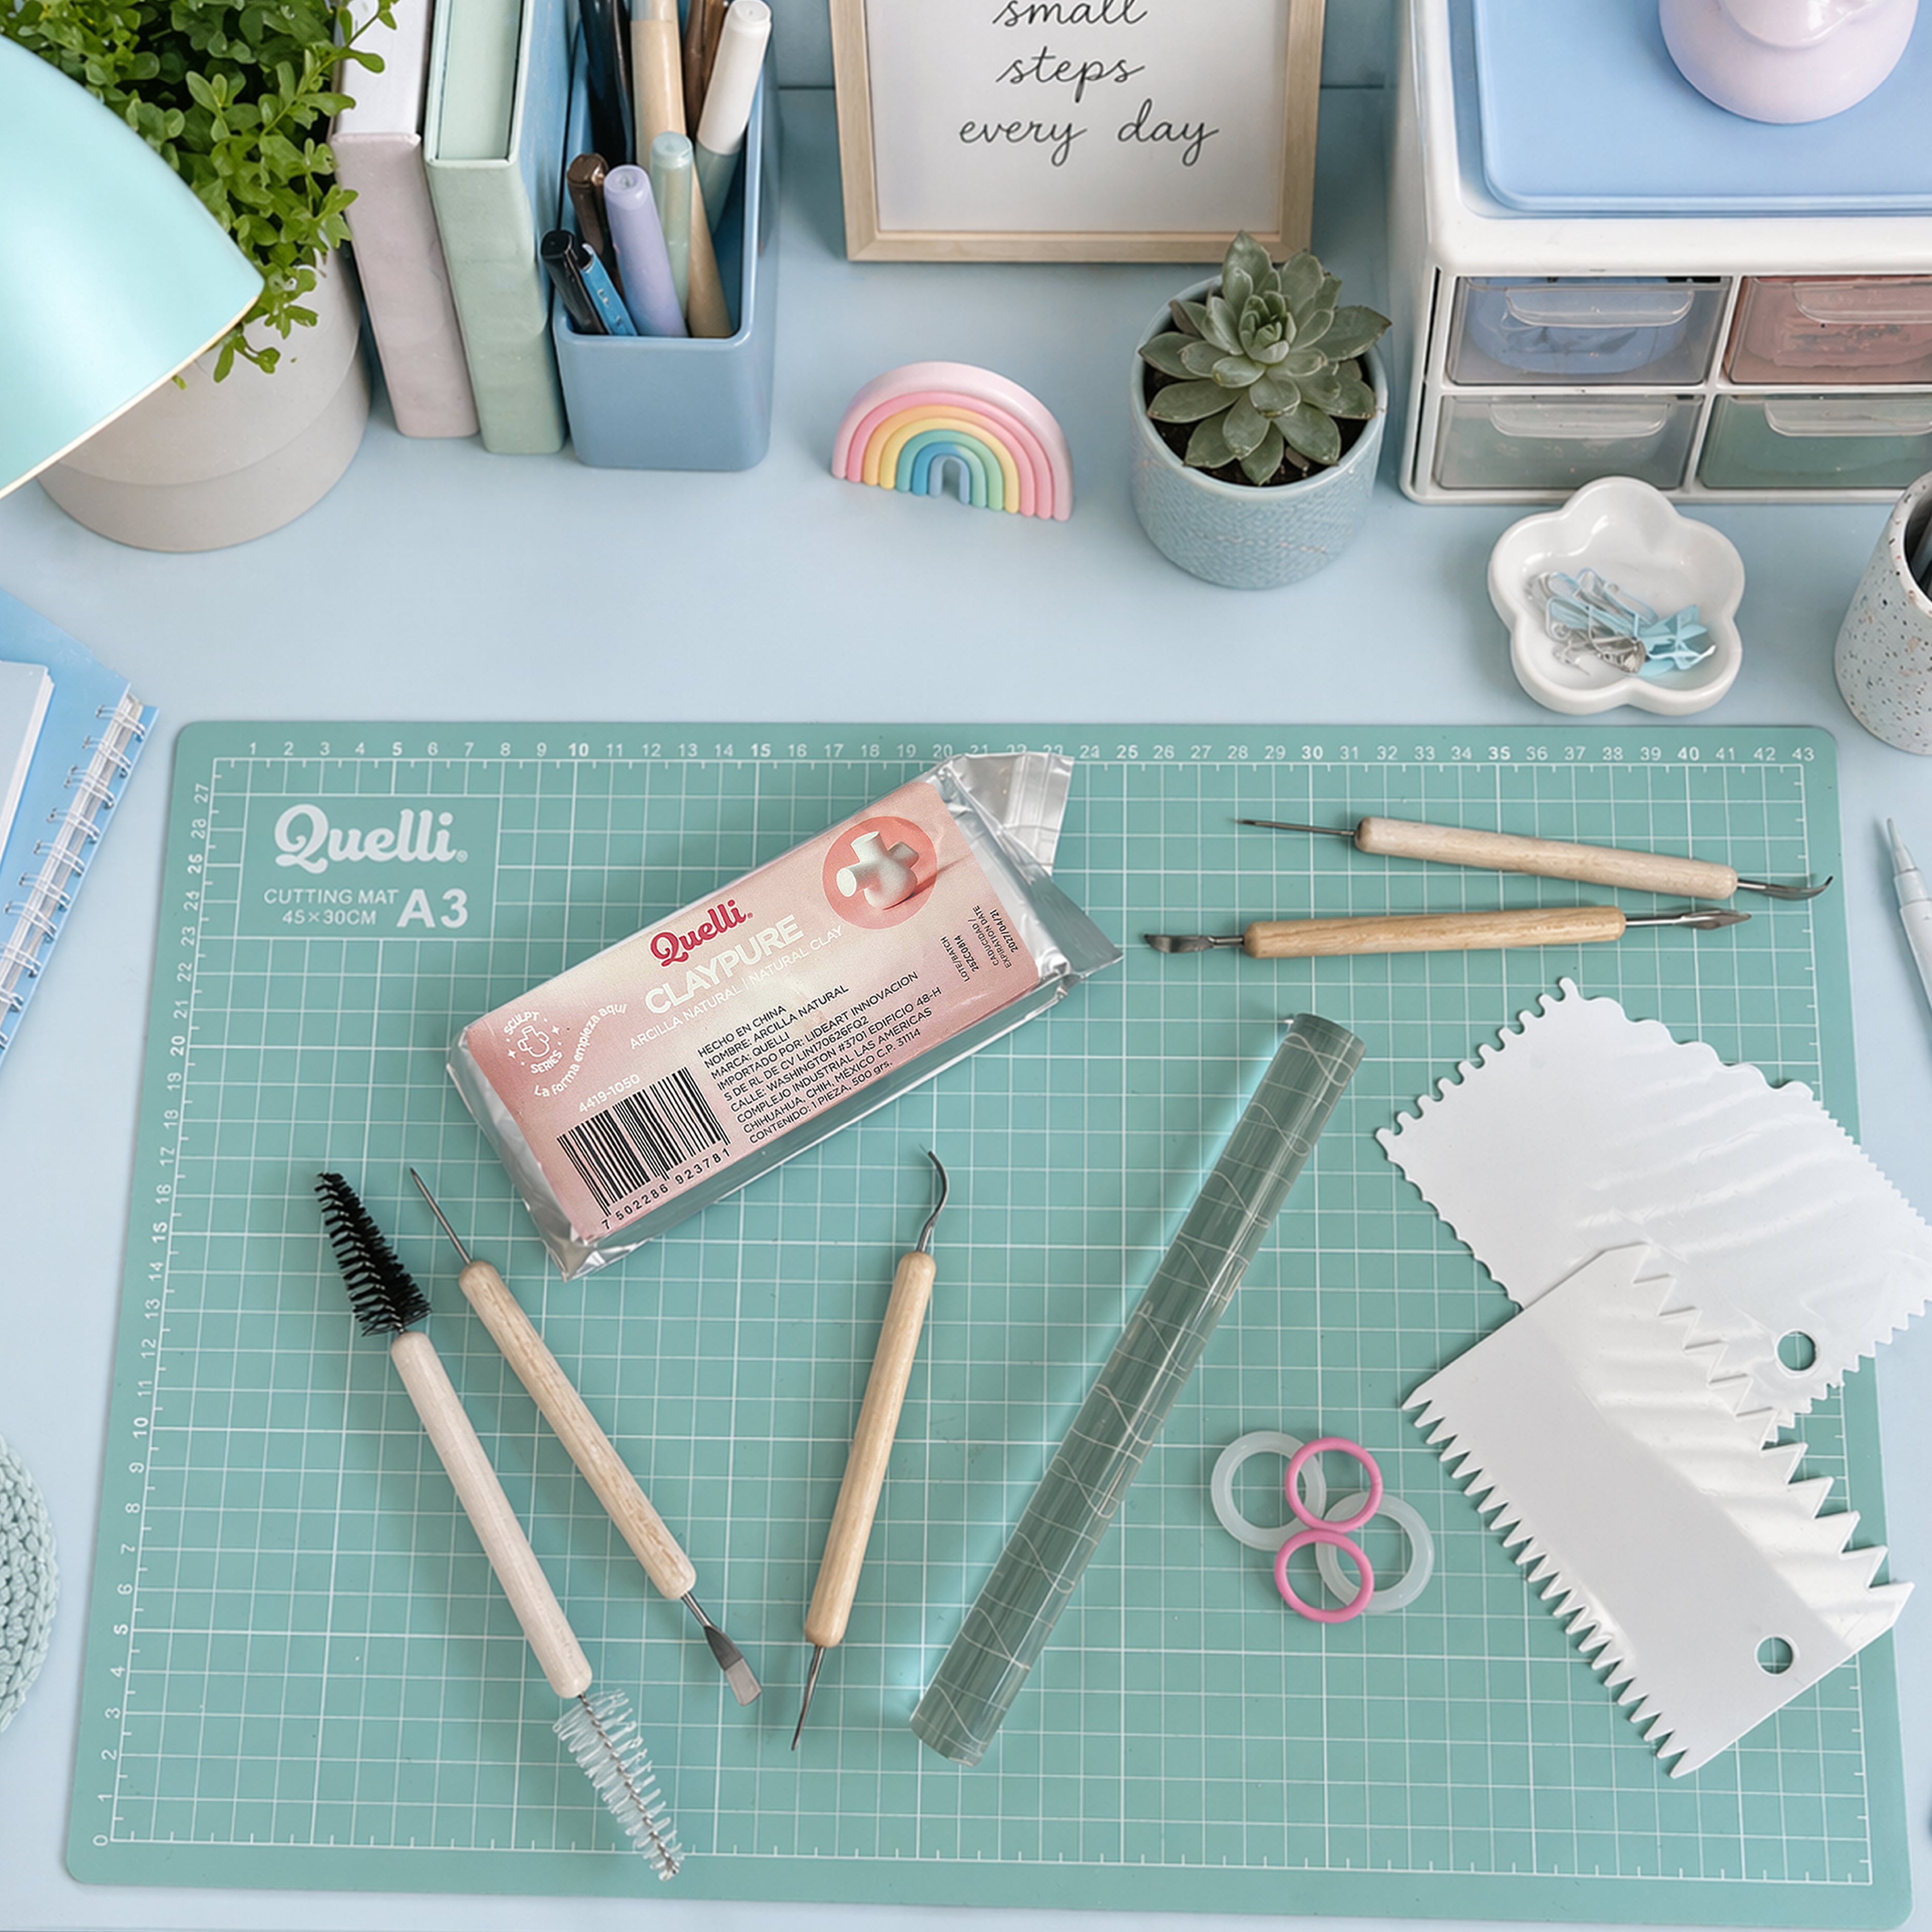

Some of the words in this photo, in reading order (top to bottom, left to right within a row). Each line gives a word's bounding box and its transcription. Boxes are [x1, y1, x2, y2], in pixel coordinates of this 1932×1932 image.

[992, 0, 1148, 27] small
[996, 46, 1146, 103] steps
[959, 118, 1088, 167] every
[1117, 98, 1220, 167] day
[250, 742, 256, 755] 1
[284, 742, 293, 756] 2
[320, 742, 330, 756] 3
[355, 742, 364, 756] 4
[392, 742, 402, 756] 5
[428, 742, 438, 756] 6
[465, 743, 474, 756] 7
[500, 743, 510, 756] 8
[537, 743, 546, 757] 9
[569, 743, 589, 757] 10
[607, 743, 622, 757] 11
[642, 743, 661, 757] 12
[679, 743, 697, 757] 13
[715, 743, 733, 757] 14
[751, 744, 770, 757] 15
[789, 744, 807, 757] 16
[825, 744, 843, 758] 17
[862, 744, 879, 758] 18
[898, 744, 915, 758] 19
[933, 744, 952, 758] 20
[1154, 745, 1174, 759] 26
[1191, 745, 1212, 759] 27
[1228, 745, 1248, 759] 28
[1265, 745, 1285, 759] 29
[1302, 746, 1323, 759] 30
[1340, 746, 1357, 760] 31
[1378, 746, 1397, 760] 32
[1415, 746, 1435, 760] 33
[1452, 746, 1471, 760] 34
[1489, 746, 1510, 760] 35
[1526, 746, 1548, 760] 36
[1565, 747, 1585, 760] 37
[1641, 747, 1661, 761] 39
[1677, 747, 1699, 761] 40
[1716, 747, 1734, 761] 41
[1754, 747, 1775, 761] 42
[1792, 747, 1814, 761] 43
[194, 783, 208, 803] 27
[264, 889, 353, 905] CUTTING
[358, 889, 399, 905] MAT
[397, 889, 468, 928] A3
[972, 905, 988, 925] DATE
[181, 927, 195, 946] 23
[990, 909, 1018, 953] 2027/04/21
[972, 923, 999, 965] CADUCIDAD
[984, 925, 1012, 969] EXPIRATION
[645, 914, 804, 1014] CLAYPURE
[940, 936, 970, 982] LOTE/BATCH
[177, 963, 192, 982] 22
[629, 1016, 683, 1050] ARCILLA
[683, 985, 742, 1021] NATURAL
[749, 947, 810, 986] NATURAL
[810, 925, 843, 950] CLAY
[174, 1001, 188, 1018] 21
[504, 1011, 539, 1035] SCULPT
[697, 1033, 735, 1058] HECHO
[736, 1024, 752, 1037] EN
[752, 1006, 786, 1027] CHINA
[704, 1039, 752, 1069] NOMBRE:
[754, 1014, 798, 1042] ARCILLA
[798, 986, 849, 1017] NATURAL
[717, 1054, 778, 1091] IMPORTADO
[778, 1039, 804, 1057] POR:
[804, 1011, 849, 1042] LIDEART
[850, 972, 918, 1016] INNOVACION
[170, 1036, 185, 1056] 20
[731, 1089, 767, 1112] CALLE:
[767, 1049, 837, 1091] WASHINGTON
[838, 1031, 867, 1053] #3701
[868, 1004, 914, 1035] EDIFICIO
[917, 987, 942, 1006] 48-H
[876, 1044, 896, 1058] C.P.
[896, 1028, 921, 1047] 31114
[530, 1050, 562, 1074] SERIES
[711, 1054, 752, 1080] MARCA:
[752, 1031, 790, 1057] QUELLI
[732, 1083, 749, 1097] DE
[748, 1077, 764, 1088] RL
[763, 1066, 780, 1080] DE
[780, 1057, 794, 1070] CV
[796, 1016, 869, 1061] LIN170626FQ2
[737, 1089, 791, 1122] COMPLEJO
[792, 1057, 854, 1092] INDUSTRIAL
[854, 1040, 876, 1058] LAS
[878, 1008, 932, 1044] AMERICAS
[167, 1073, 182, 1090] 19
[534, 1085, 550, 1097] La
[579, 1074, 640, 1113] 4419-1050
[749, 1106, 811, 1143] CONTENIDO:
[851, 1070, 872, 1086] 500
[873, 1061, 893, 1075] grs.
[164, 1110, 178, 1129] 18
[160, 1147, 175, 1166] 17
[155, 1184, 171, 1203] 16
[602, 1220, 610, 1230] 7
[615, 1183, 669, 1220] 502286
[675, 1148, 731, 1184] 923781
[152, 1222, 168, 1243] 15
[148, 1262, 163, 1281] 14
[145, 1299, 160, 1319] 13
[141, 1339, 156, 1358] 12
[138, 1381, 152, 1396] 11
[133, 1417, 148, 1438] 10
[129, 1463, 144, 1473] 9
[125, 1503, 140, 1513] 8
[121, 1544, 135, 1554] 7
[117, 1584, 132, 1594] 6
[114, 1624, 128, 1635] 5
[110, 1666, 125, 1677] 4
[105, 1708, 120, 1718] 3
[101, 1750, 117, 1760] 2
[93, 1835, 108, 1846] 0
